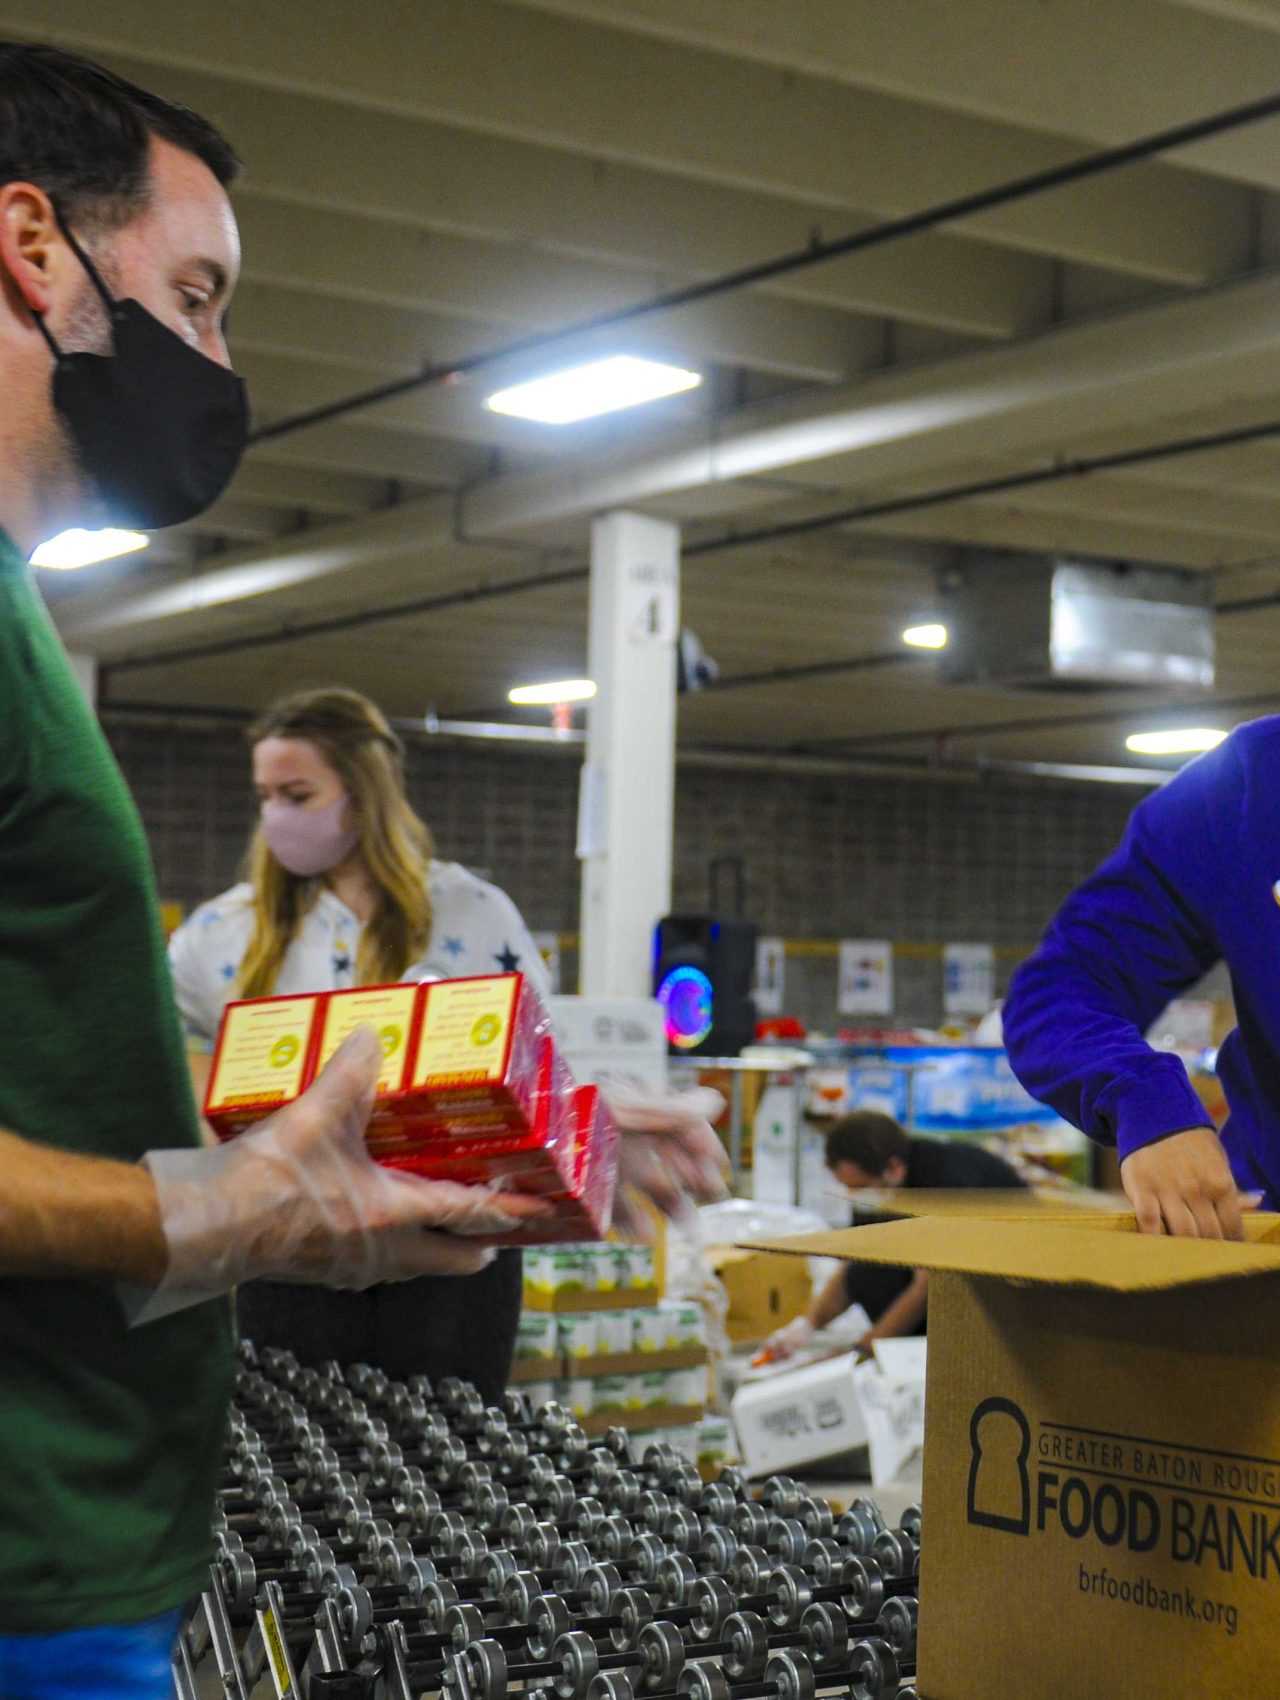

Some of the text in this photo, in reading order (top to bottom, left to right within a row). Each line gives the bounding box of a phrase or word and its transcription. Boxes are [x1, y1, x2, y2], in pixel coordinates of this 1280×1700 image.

[1038, 1433, 1124, 1469] GREATER
[1133, 1451, 1202, 1482] BATON
[1038, 1472, 1161, 1552] FOOD
[1079, 1564, 1238, 1634] brfoodbank.org
